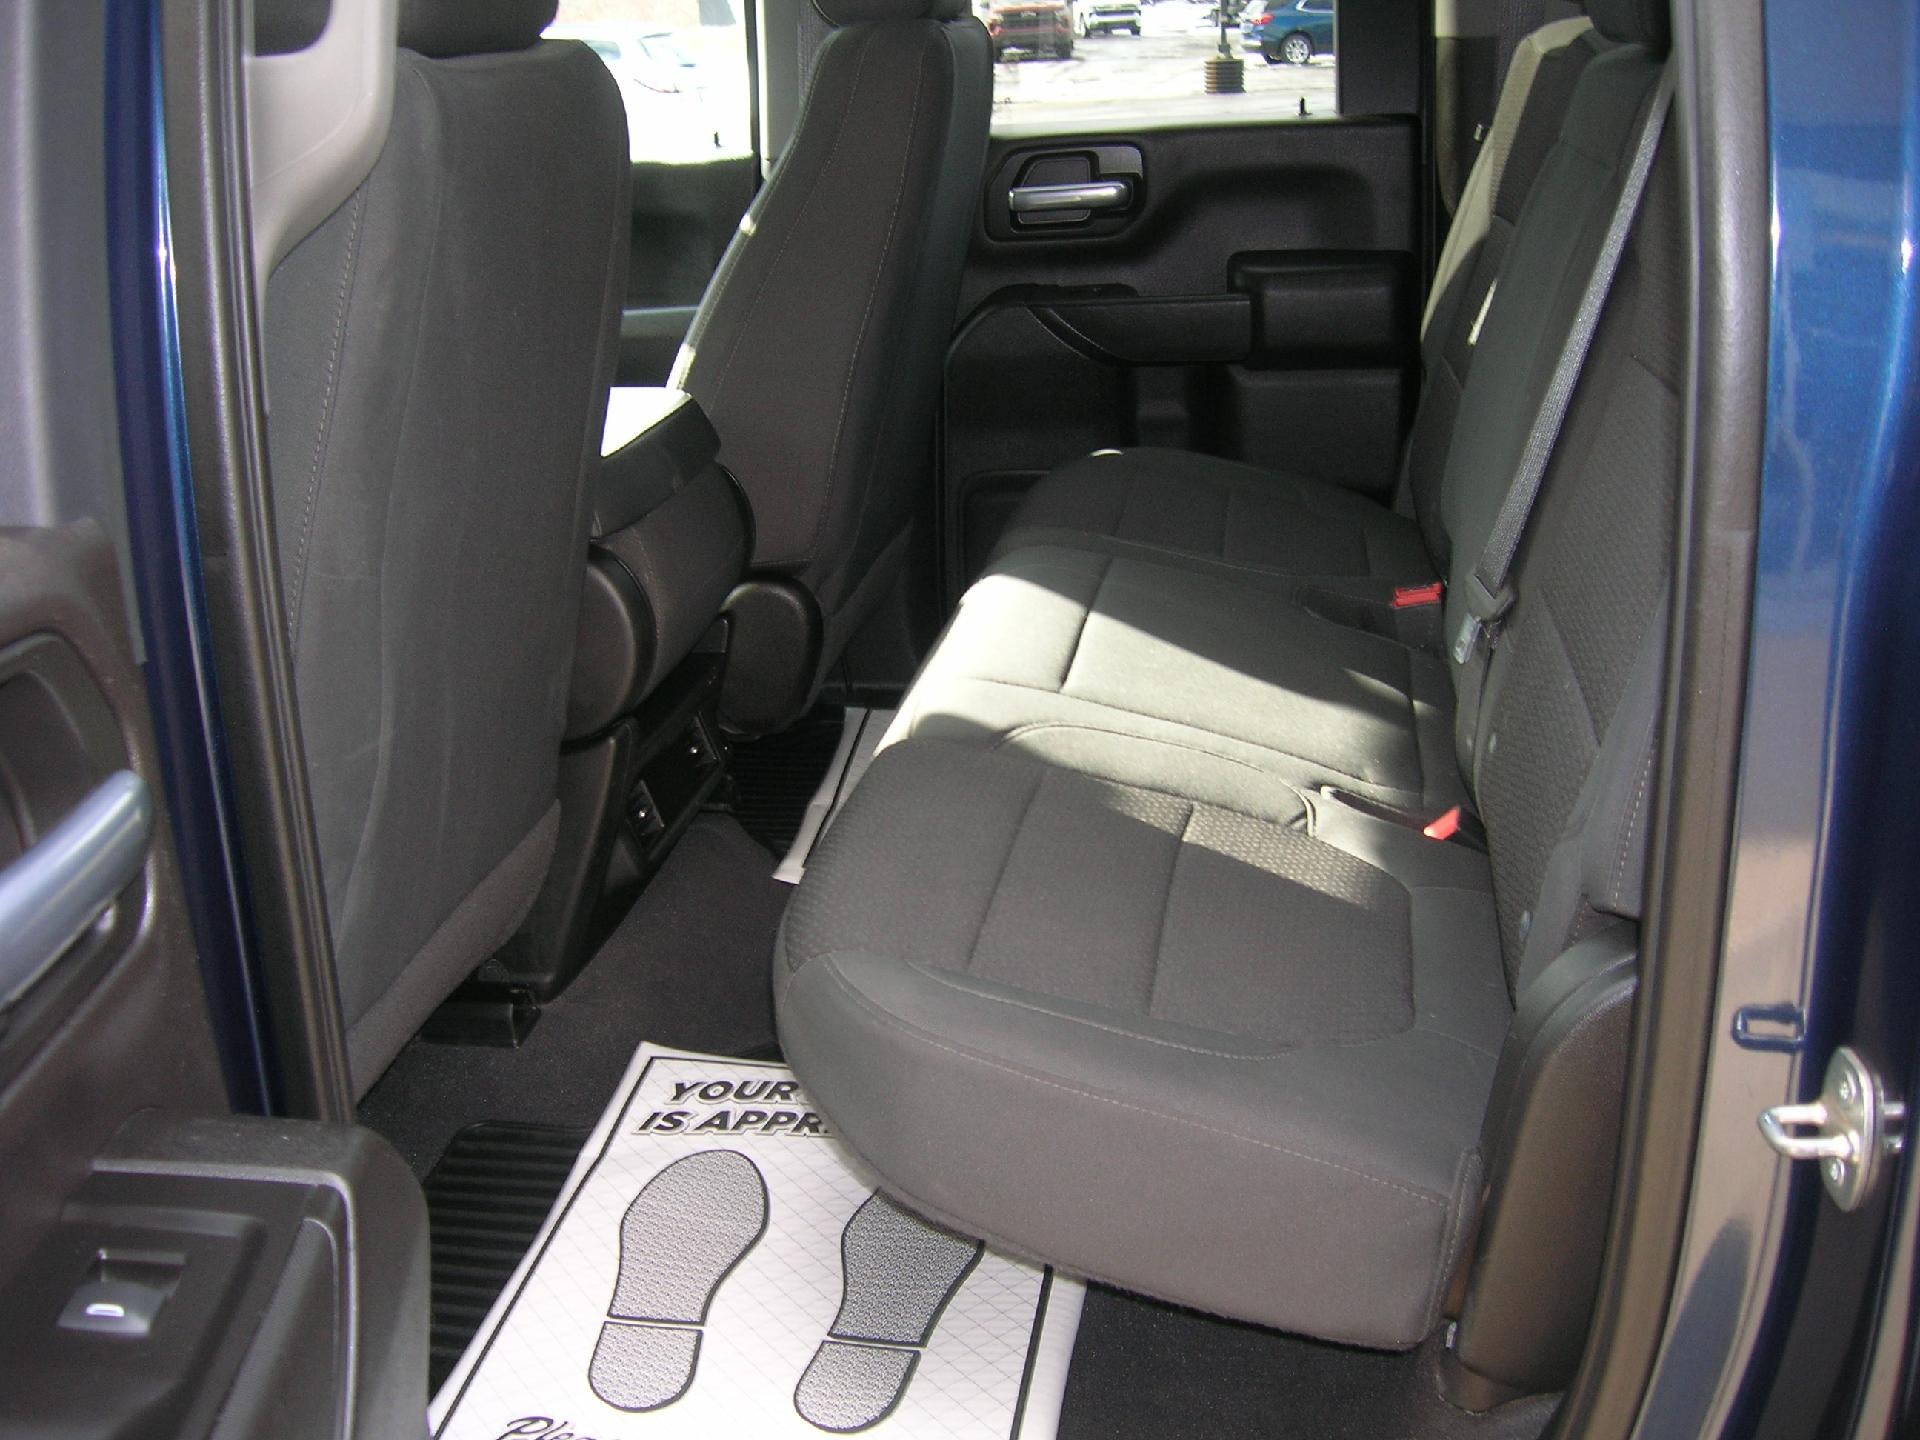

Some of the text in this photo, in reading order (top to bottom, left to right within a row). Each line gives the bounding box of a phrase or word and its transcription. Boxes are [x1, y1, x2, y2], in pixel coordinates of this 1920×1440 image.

[669, 1080, 802, 1102] YOUR
[636, 1110, 831, 1134] IS APPR
